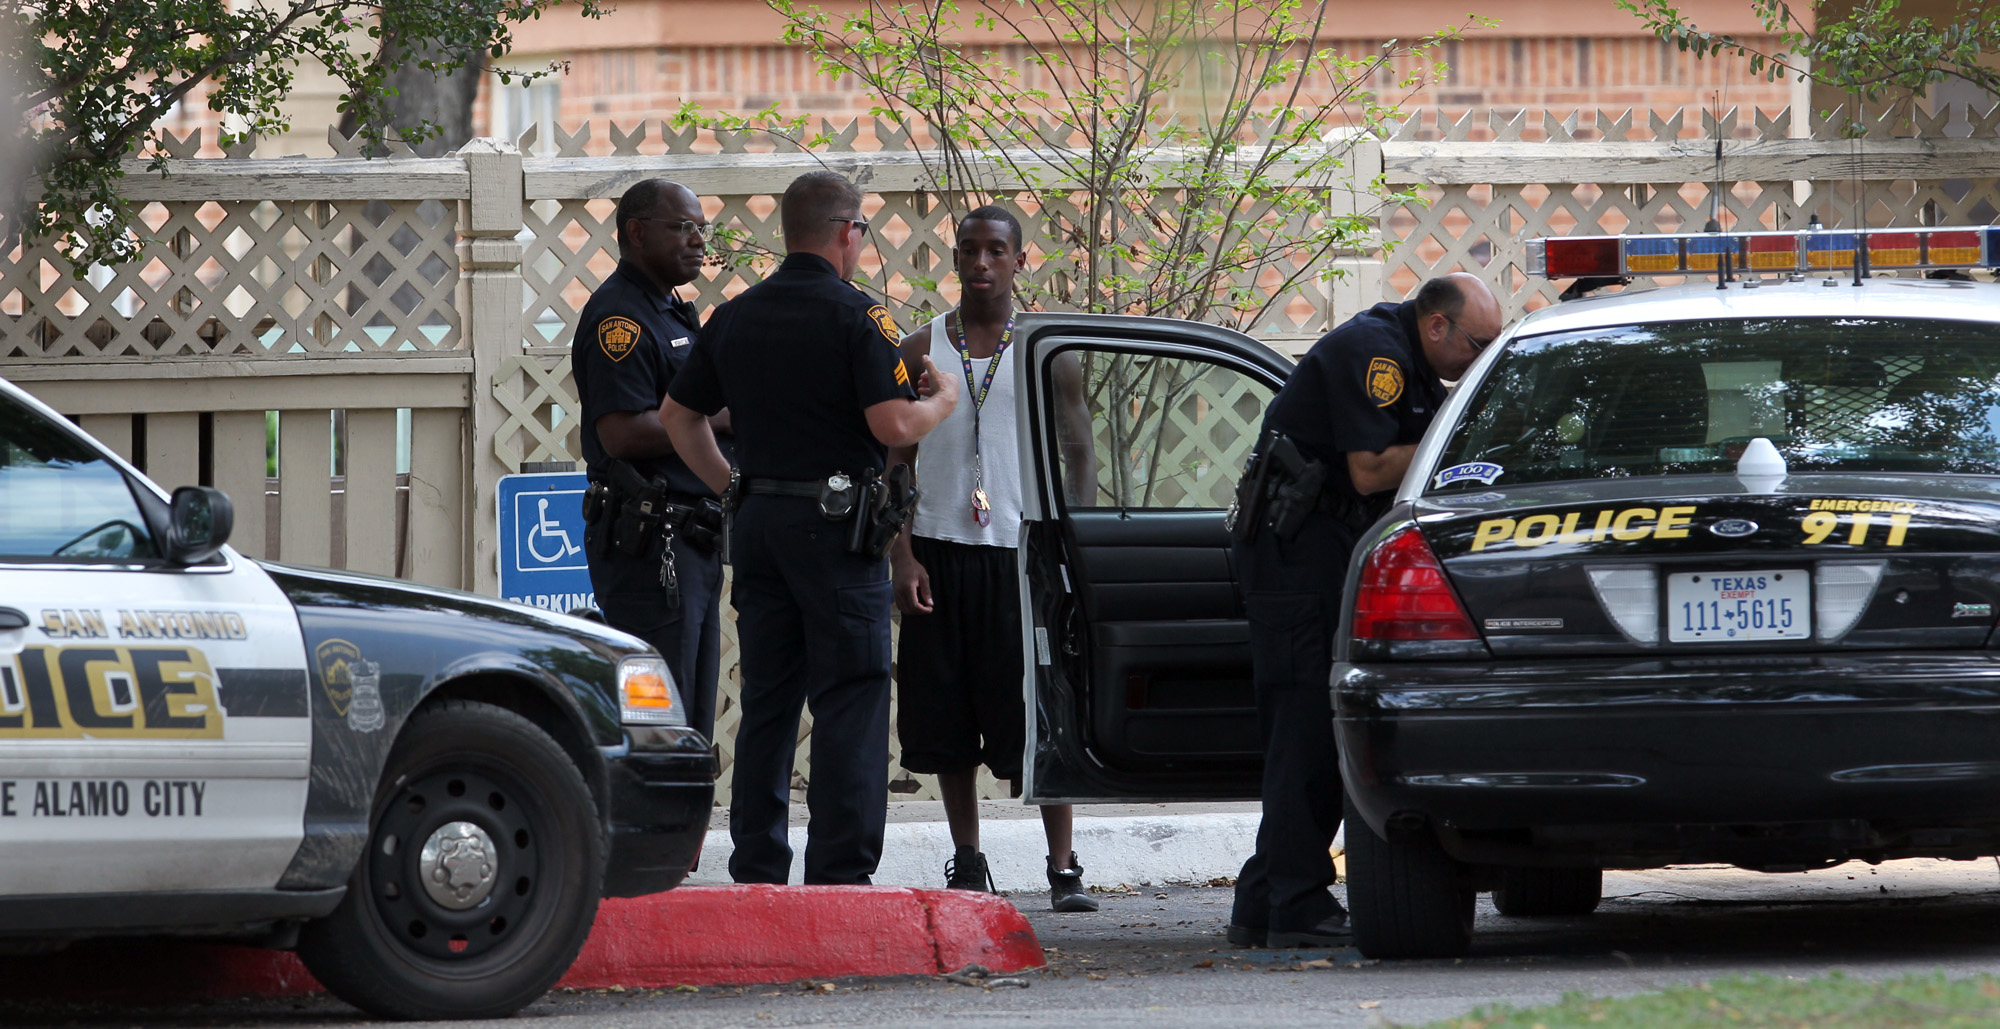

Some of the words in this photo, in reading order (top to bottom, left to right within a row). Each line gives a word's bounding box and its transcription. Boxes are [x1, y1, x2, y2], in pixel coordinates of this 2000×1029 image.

[607, 343, 627, 352] POLICE
[1458, 465, 1484, 475] 100
[1809, 499, 1917, 513] EMERGENCY
[1471, 506, 1697, 552] POLICE
[1801, 511, 1912, 546] 911
[1711, 576, 1767, 591] TEXAS
[1720, 590, 1756, 600] EXEMPT
[38, 608, 109, 638] SAN
[116, 609, 248, 640] ANTONIO
[32, 780, 129, 817] ALAMO
[143, 780, 206, 817] CITY
